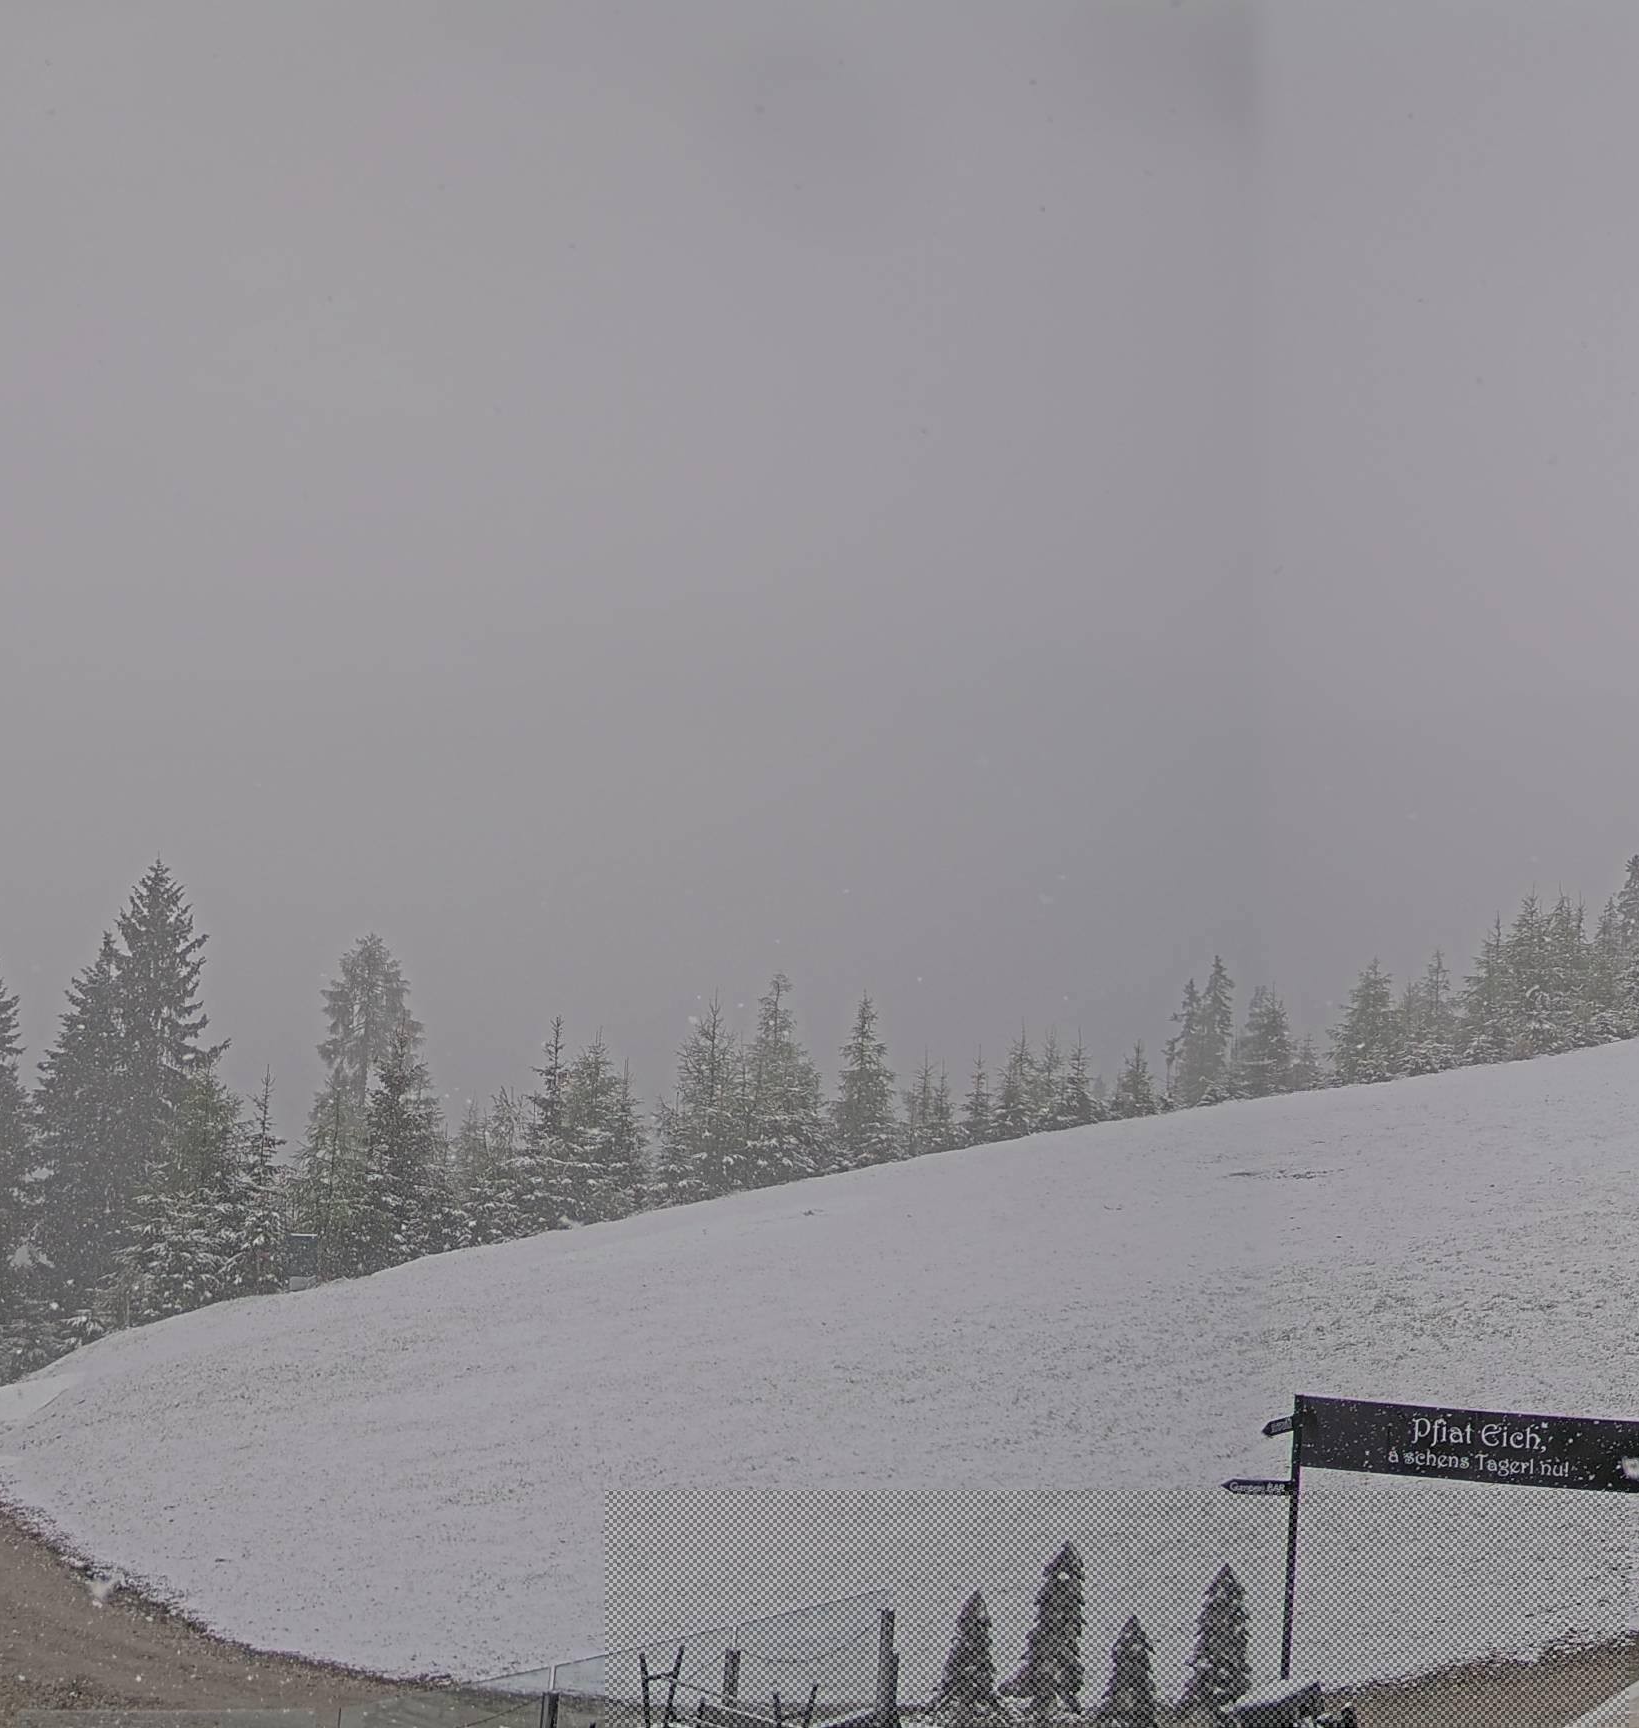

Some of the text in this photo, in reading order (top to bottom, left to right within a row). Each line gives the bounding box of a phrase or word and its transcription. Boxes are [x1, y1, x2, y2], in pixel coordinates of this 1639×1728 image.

[1412, 1417, 1547, 1453] Pfiat Eich,
[1474, 1453, 1534, 1477] Tagerl
